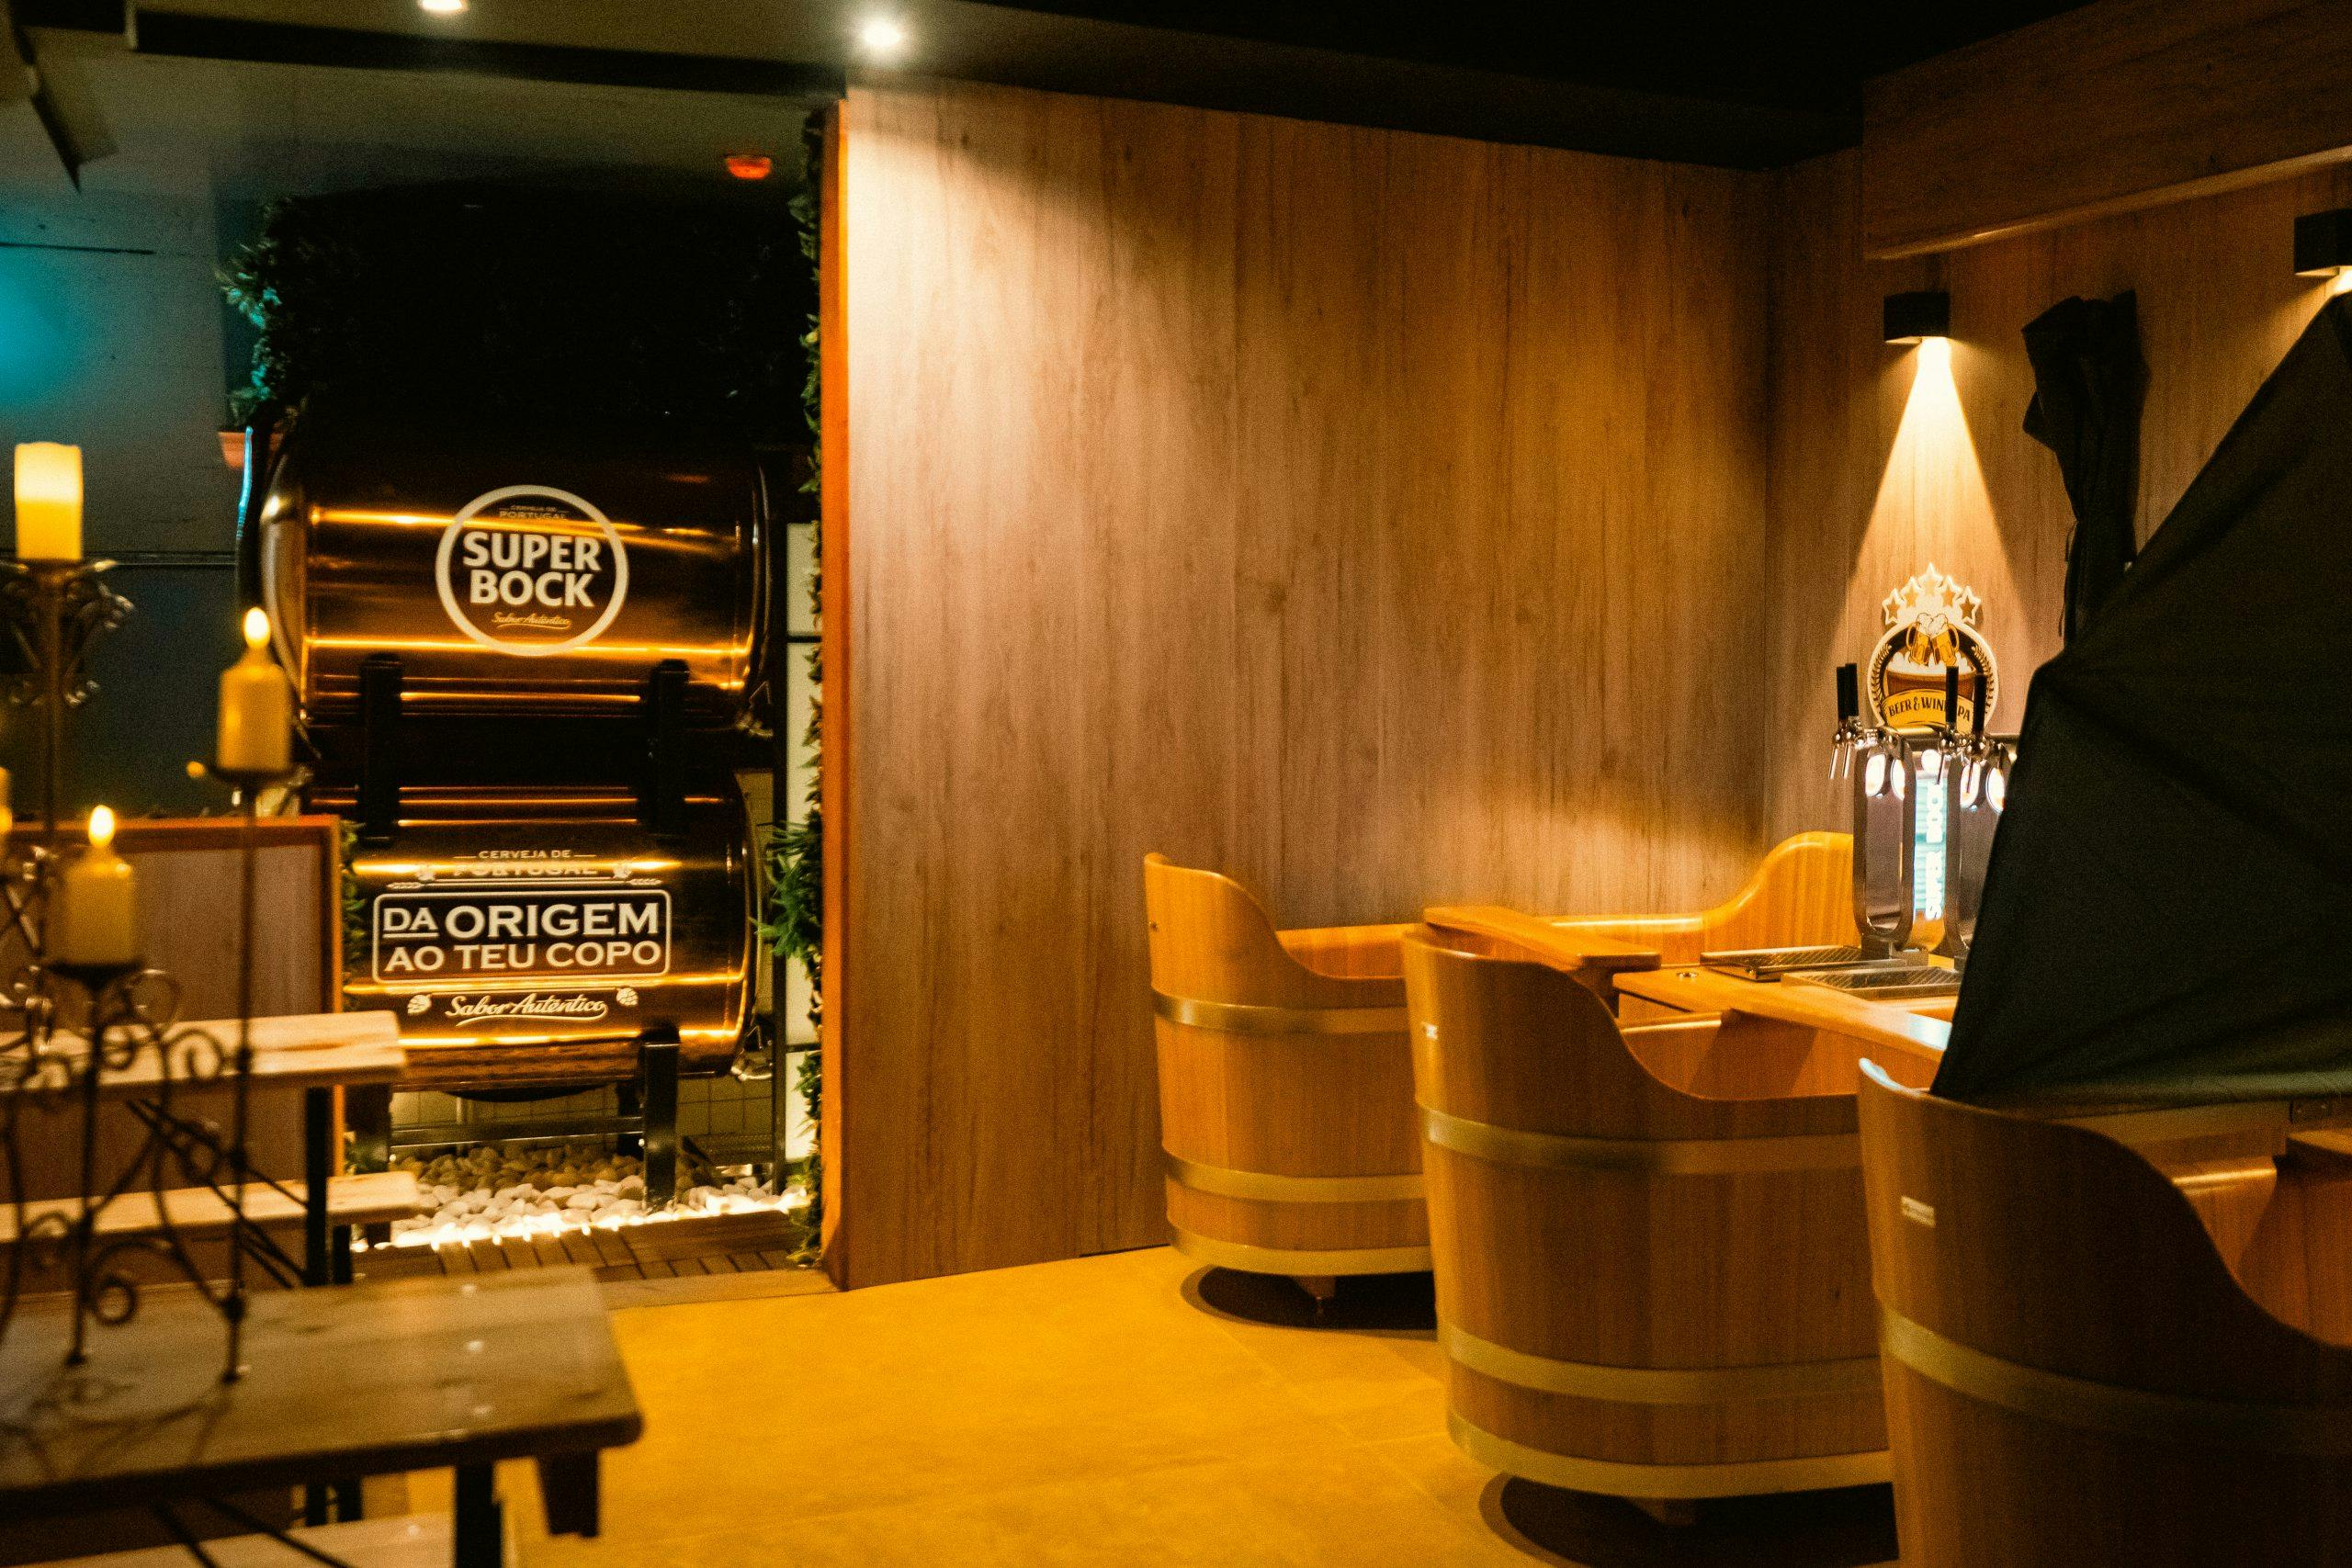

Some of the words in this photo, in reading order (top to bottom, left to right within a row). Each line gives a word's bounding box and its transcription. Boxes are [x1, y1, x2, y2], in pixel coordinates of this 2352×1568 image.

[462, 531, 601, 570] SUPER
[469, 569, 594, 607] BOCK
[1888, 699, 1912, 716] BEER
[1913, 696, 1920, 711] &
[1921, 696, 1946, 712] WIN
[478, 851, 547, 860] CERVEJA
[550, 850, 571, 860] DE
[382, 908, 439, 932] DA
[445, 903, 659, 940] ORIGEM
[383, 946, 446, 973] AO
[454, 943, 537, 970] TEU
[546, 941, 662, 968] COPO
[445, 995, 516, 1018] Sabor
